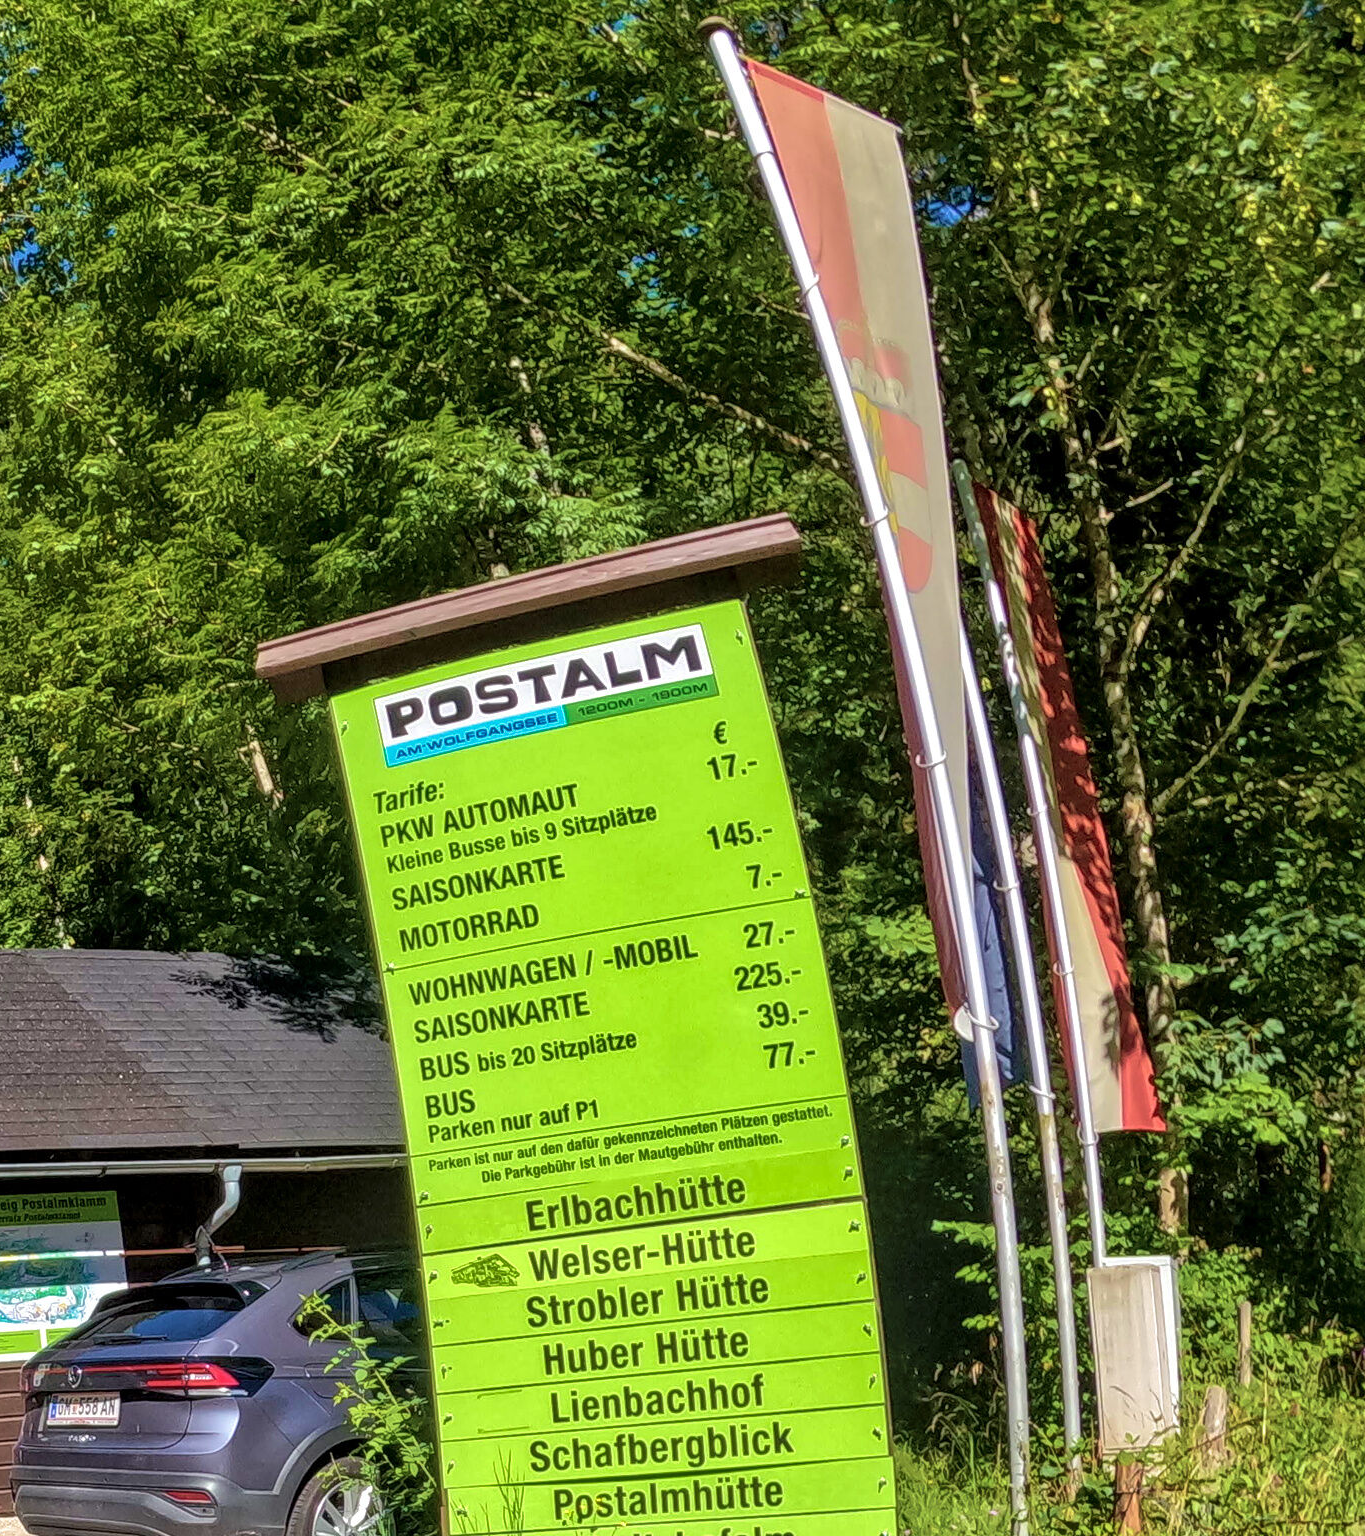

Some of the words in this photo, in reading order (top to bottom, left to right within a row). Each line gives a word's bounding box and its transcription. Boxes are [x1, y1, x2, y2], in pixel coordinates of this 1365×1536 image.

[385, 634, 703, 739] POSTALM
[578, 698, 634, 718] 1200M
[651, 682, 709, 702] 1900M
[395, 744, 423, 760] AM
[427, 712, 558, 752] WOLFGANGSEE
[713, 720, 728, 744] €
[707, 753, 758, 780] 17.-
[373, 781, 445, 814] Tarife:
[380, 815, 434, 847] PKW
[443, 783, 578, 834] AUTOMAUT
[386, 848, 444, 874] Kleine
[449, 835, 506, 861] Busse
[511, 827, 541, 848] bis
[544, 822, 559, 841] 9
[563, 806, 657, 837] Sitzplätze
[707, 820, 773, 850] 145.-
[392, 854, 566, 911] SAISONKARTE
[746, 864, 782, 889] 7.-
[399, 903, 539, 952] MOTORRAD
[743, 921, 795, 949] 27.-
[409, 953, 577, 1006] WOHNWAGEN
[585, 950, 593, 976] /
[603, 934, 699, 970] -MOBIL
[733, 961, 802, 992] 225.-
[414, 991, 590, 1044] SAISONKARTE
[757, 1001, 809, 1029] 39.-
[419, 1051, 470, 1081] BUS
[477, 1053, 507, 1072] bis
[512, 1045, 536, 1067] 20
[541, 1032, 637, 1062] Sitzplätze
[763, 1041, 816, 1070] 77.-
[424, 1089, 476, 1119] BUS
[428, 1119, 496, 1143] Parken
[501, 1112, 533, 1132] nur
[539, 1103, 571, 1126] auf
[575, 1099, 599, 1121] P1
[428, 1155, 471, 1172] Parken
[474, 1153, 491, 1165] ist
[493, 1149, 514, 1164] nur
[517, 1144, 538, 1159] auf
[540, 1142, 564, 1156] den
[566, 1136, 600, 1153] dafür
[603, 1121, 718, 1149] gekennzeichneten
[721, 1113, 769, 1131] Plätzen
[772, 1104, 833, 1128] gestattet.
[481, 1170, 502, 1184] Die
[505, 1159, 577, 1181] Parkgebühr
[579, 1156, 596, 1170] ist
[598, 1153, 611, 1167] in
[614, 1151, 635, 1165] der
[638, 1140, 715, 1162] Mautgebühr
[718, 1132, 783, 1152] enthalten.
[22, 1195, 107, 1210] Postalmklamm
[526, 1175, 746, 1231] Erlbachhütte
[528, 1227, 756, 1282] Welser-Hütte
[526, 1286, 664, 1328] Strobler
[676, 1274, 769, 1312] Hütte
[543, 1339, 644, 1376] Huber
[656, 1327, 749, 1365] Hütte
[550, 1373, 765, 1423] Lienbachhof
[529, 1421, 795, 1473] Schafbergblick
[553, 1476, 784, 1521] Postalmhütte
